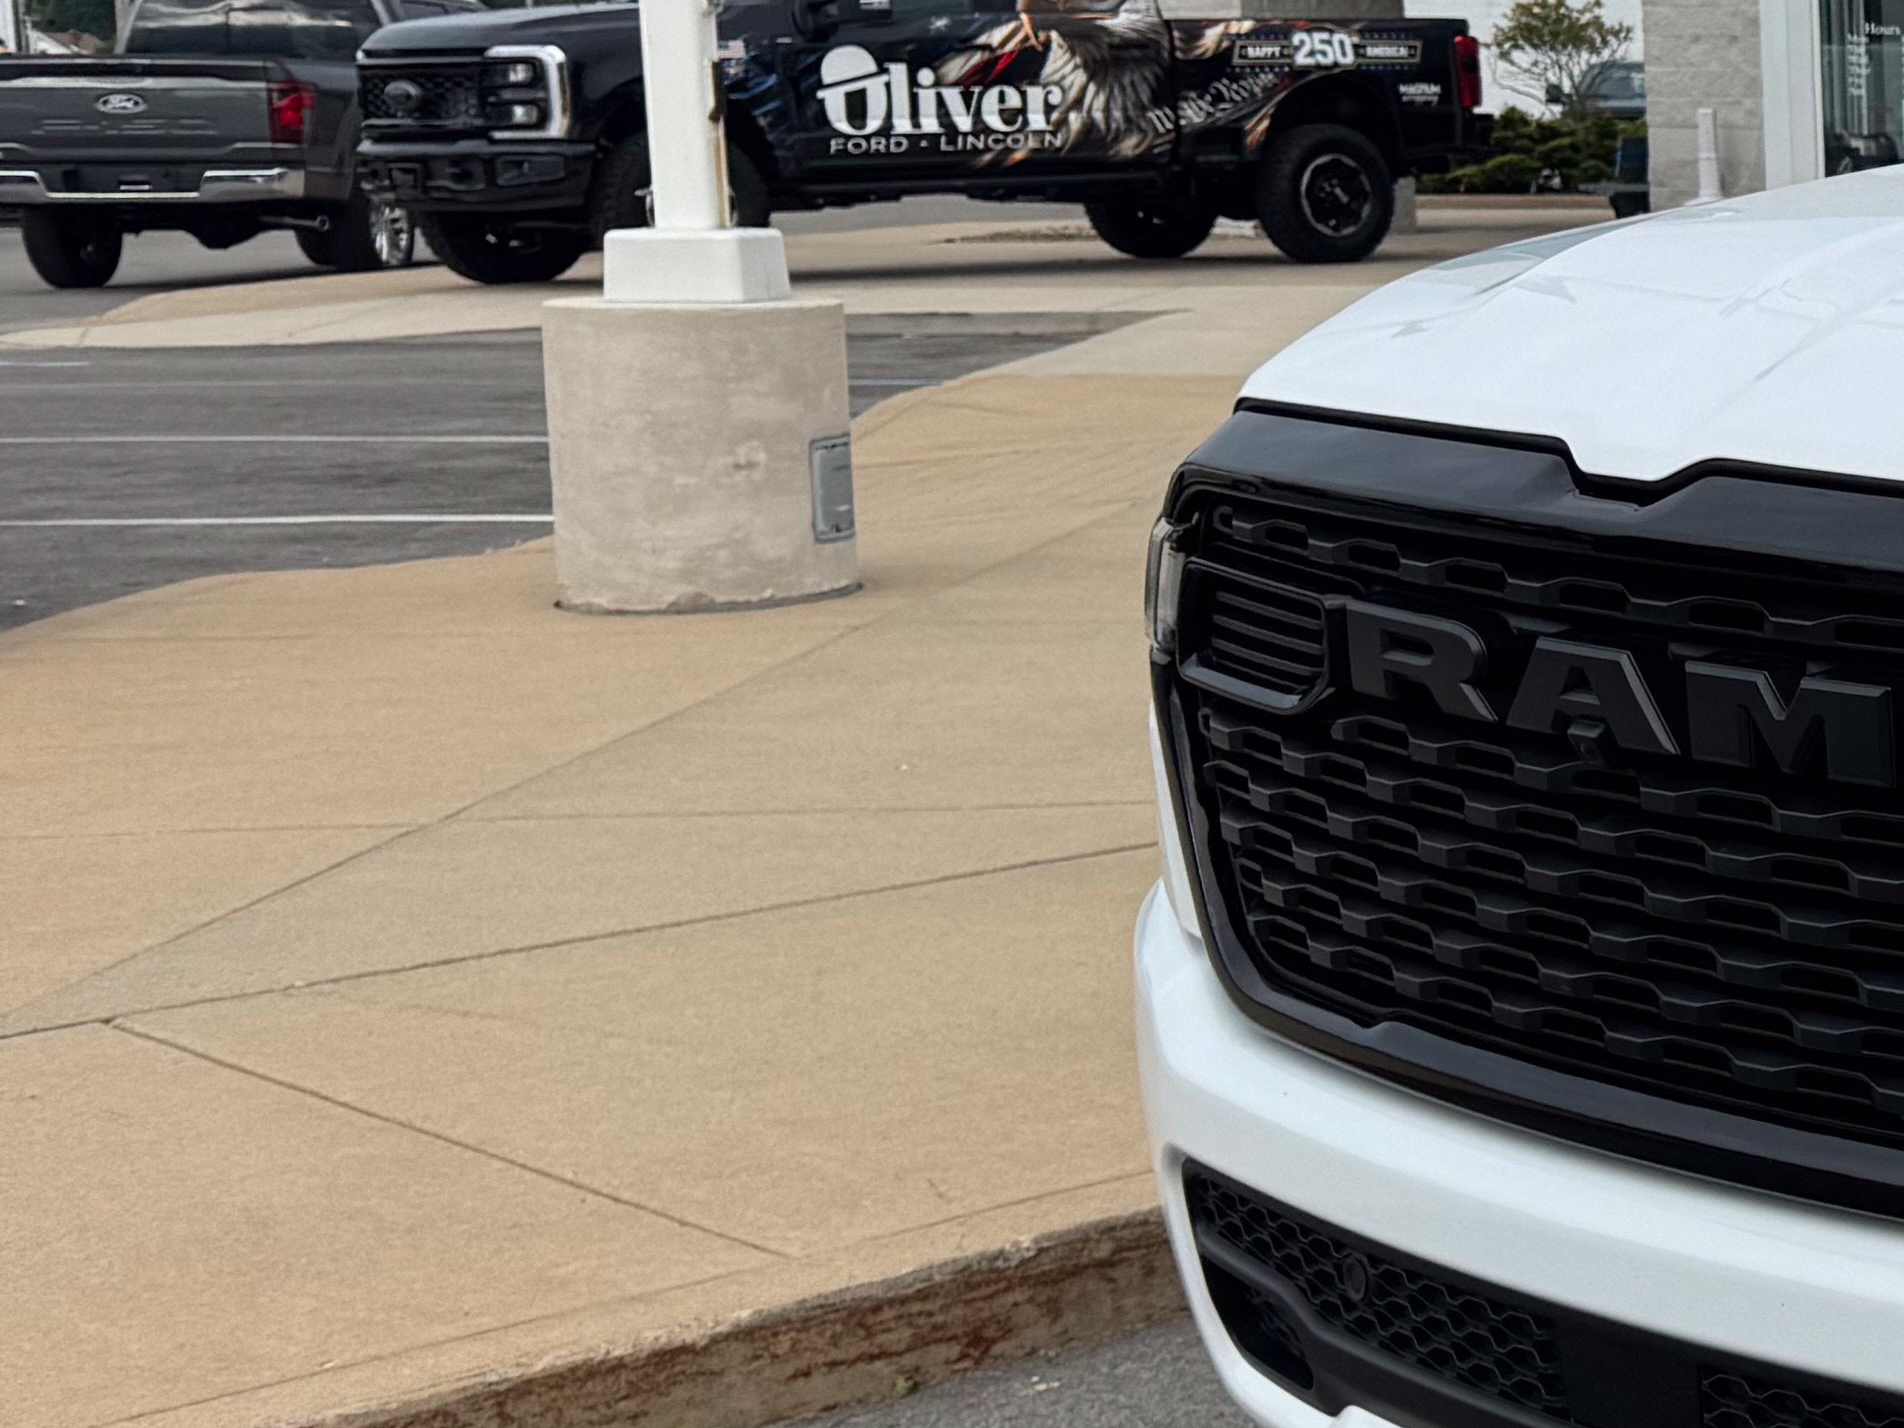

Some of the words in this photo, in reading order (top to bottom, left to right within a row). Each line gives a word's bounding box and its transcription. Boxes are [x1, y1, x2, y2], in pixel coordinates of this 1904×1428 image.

[816, 44, 1064, 136] Oliver
[829, 136, 910, 155] FORD
[939, 132, 1063, 152] LINCOLN
[1346, 597, 1898, 789] RAM
